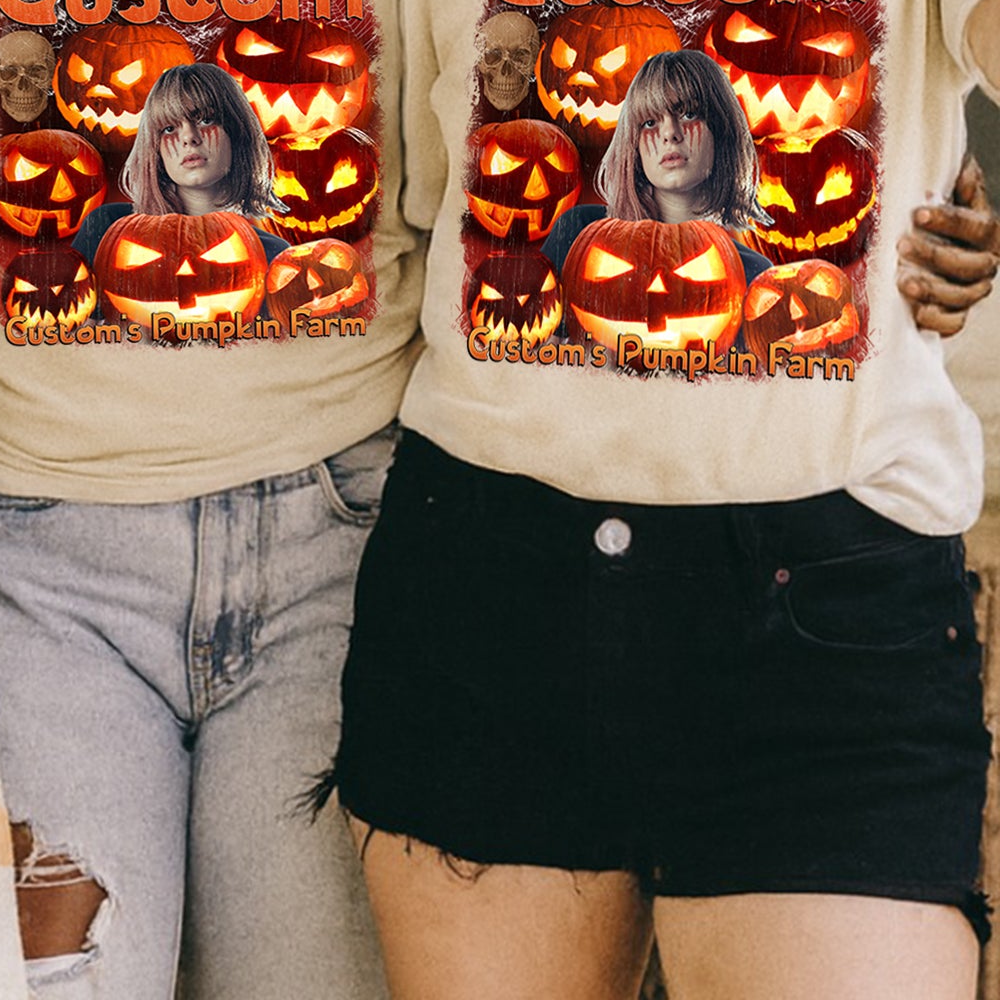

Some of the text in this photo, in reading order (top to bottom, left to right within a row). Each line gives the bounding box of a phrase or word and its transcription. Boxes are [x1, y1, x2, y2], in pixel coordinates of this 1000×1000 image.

[5, 309, 366, 347] Custom's Pumpkin Farm
[467, 326, 855, 382] Custom's Pumpkin Farm
